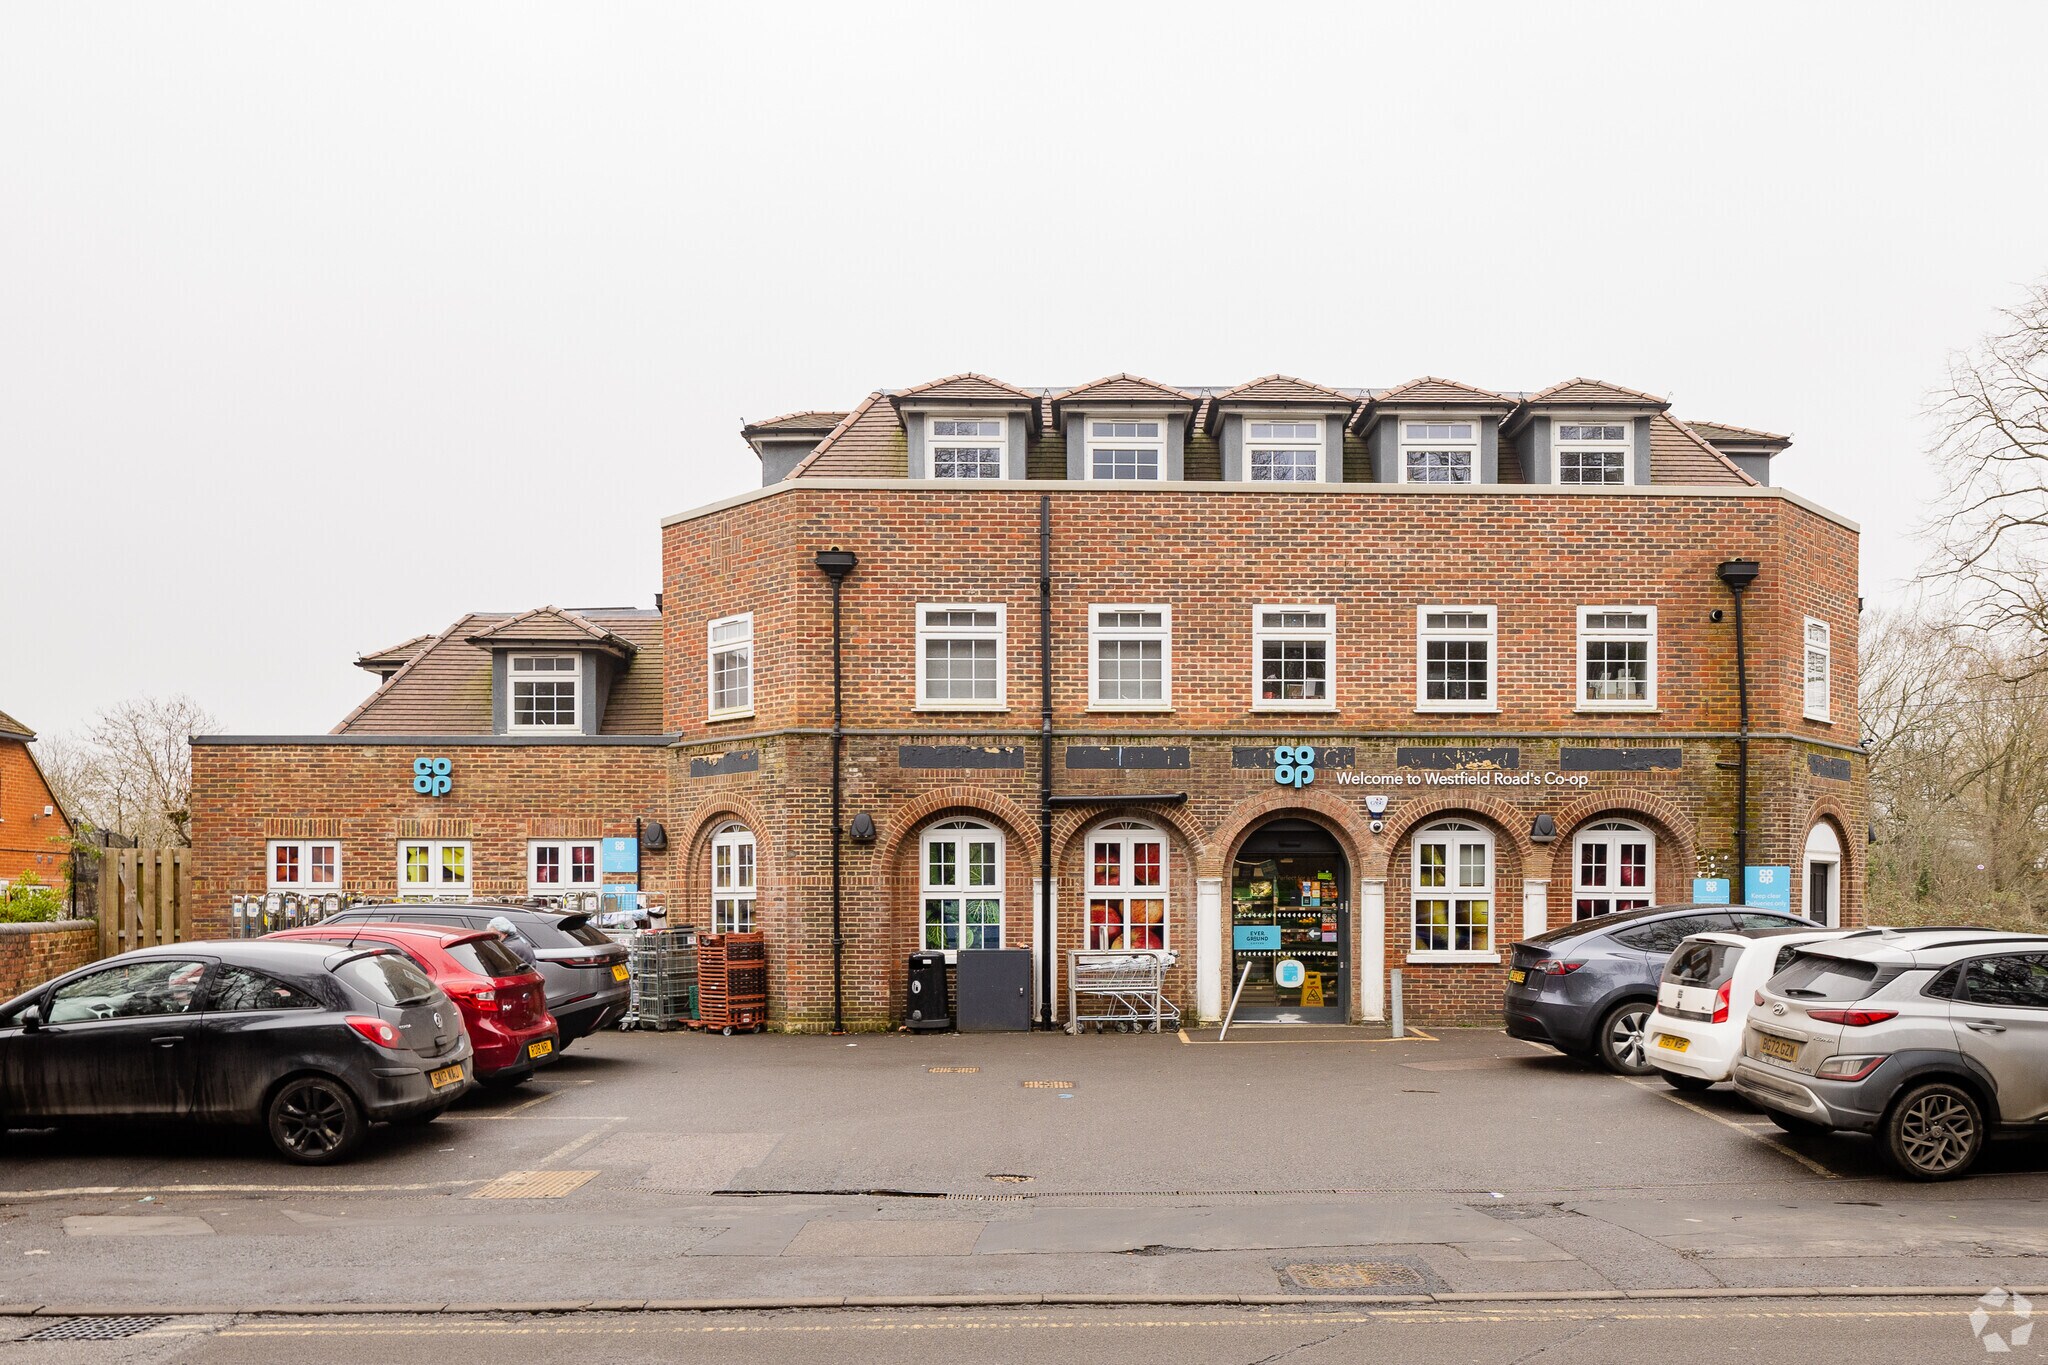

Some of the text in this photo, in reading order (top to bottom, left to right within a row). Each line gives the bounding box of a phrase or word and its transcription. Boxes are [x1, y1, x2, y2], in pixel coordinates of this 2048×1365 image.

[1336, 771, 1588, 788] Welcome to Westfield Road's Co-op
[1762, 1038, 1796, 1059] BG72 GZW
